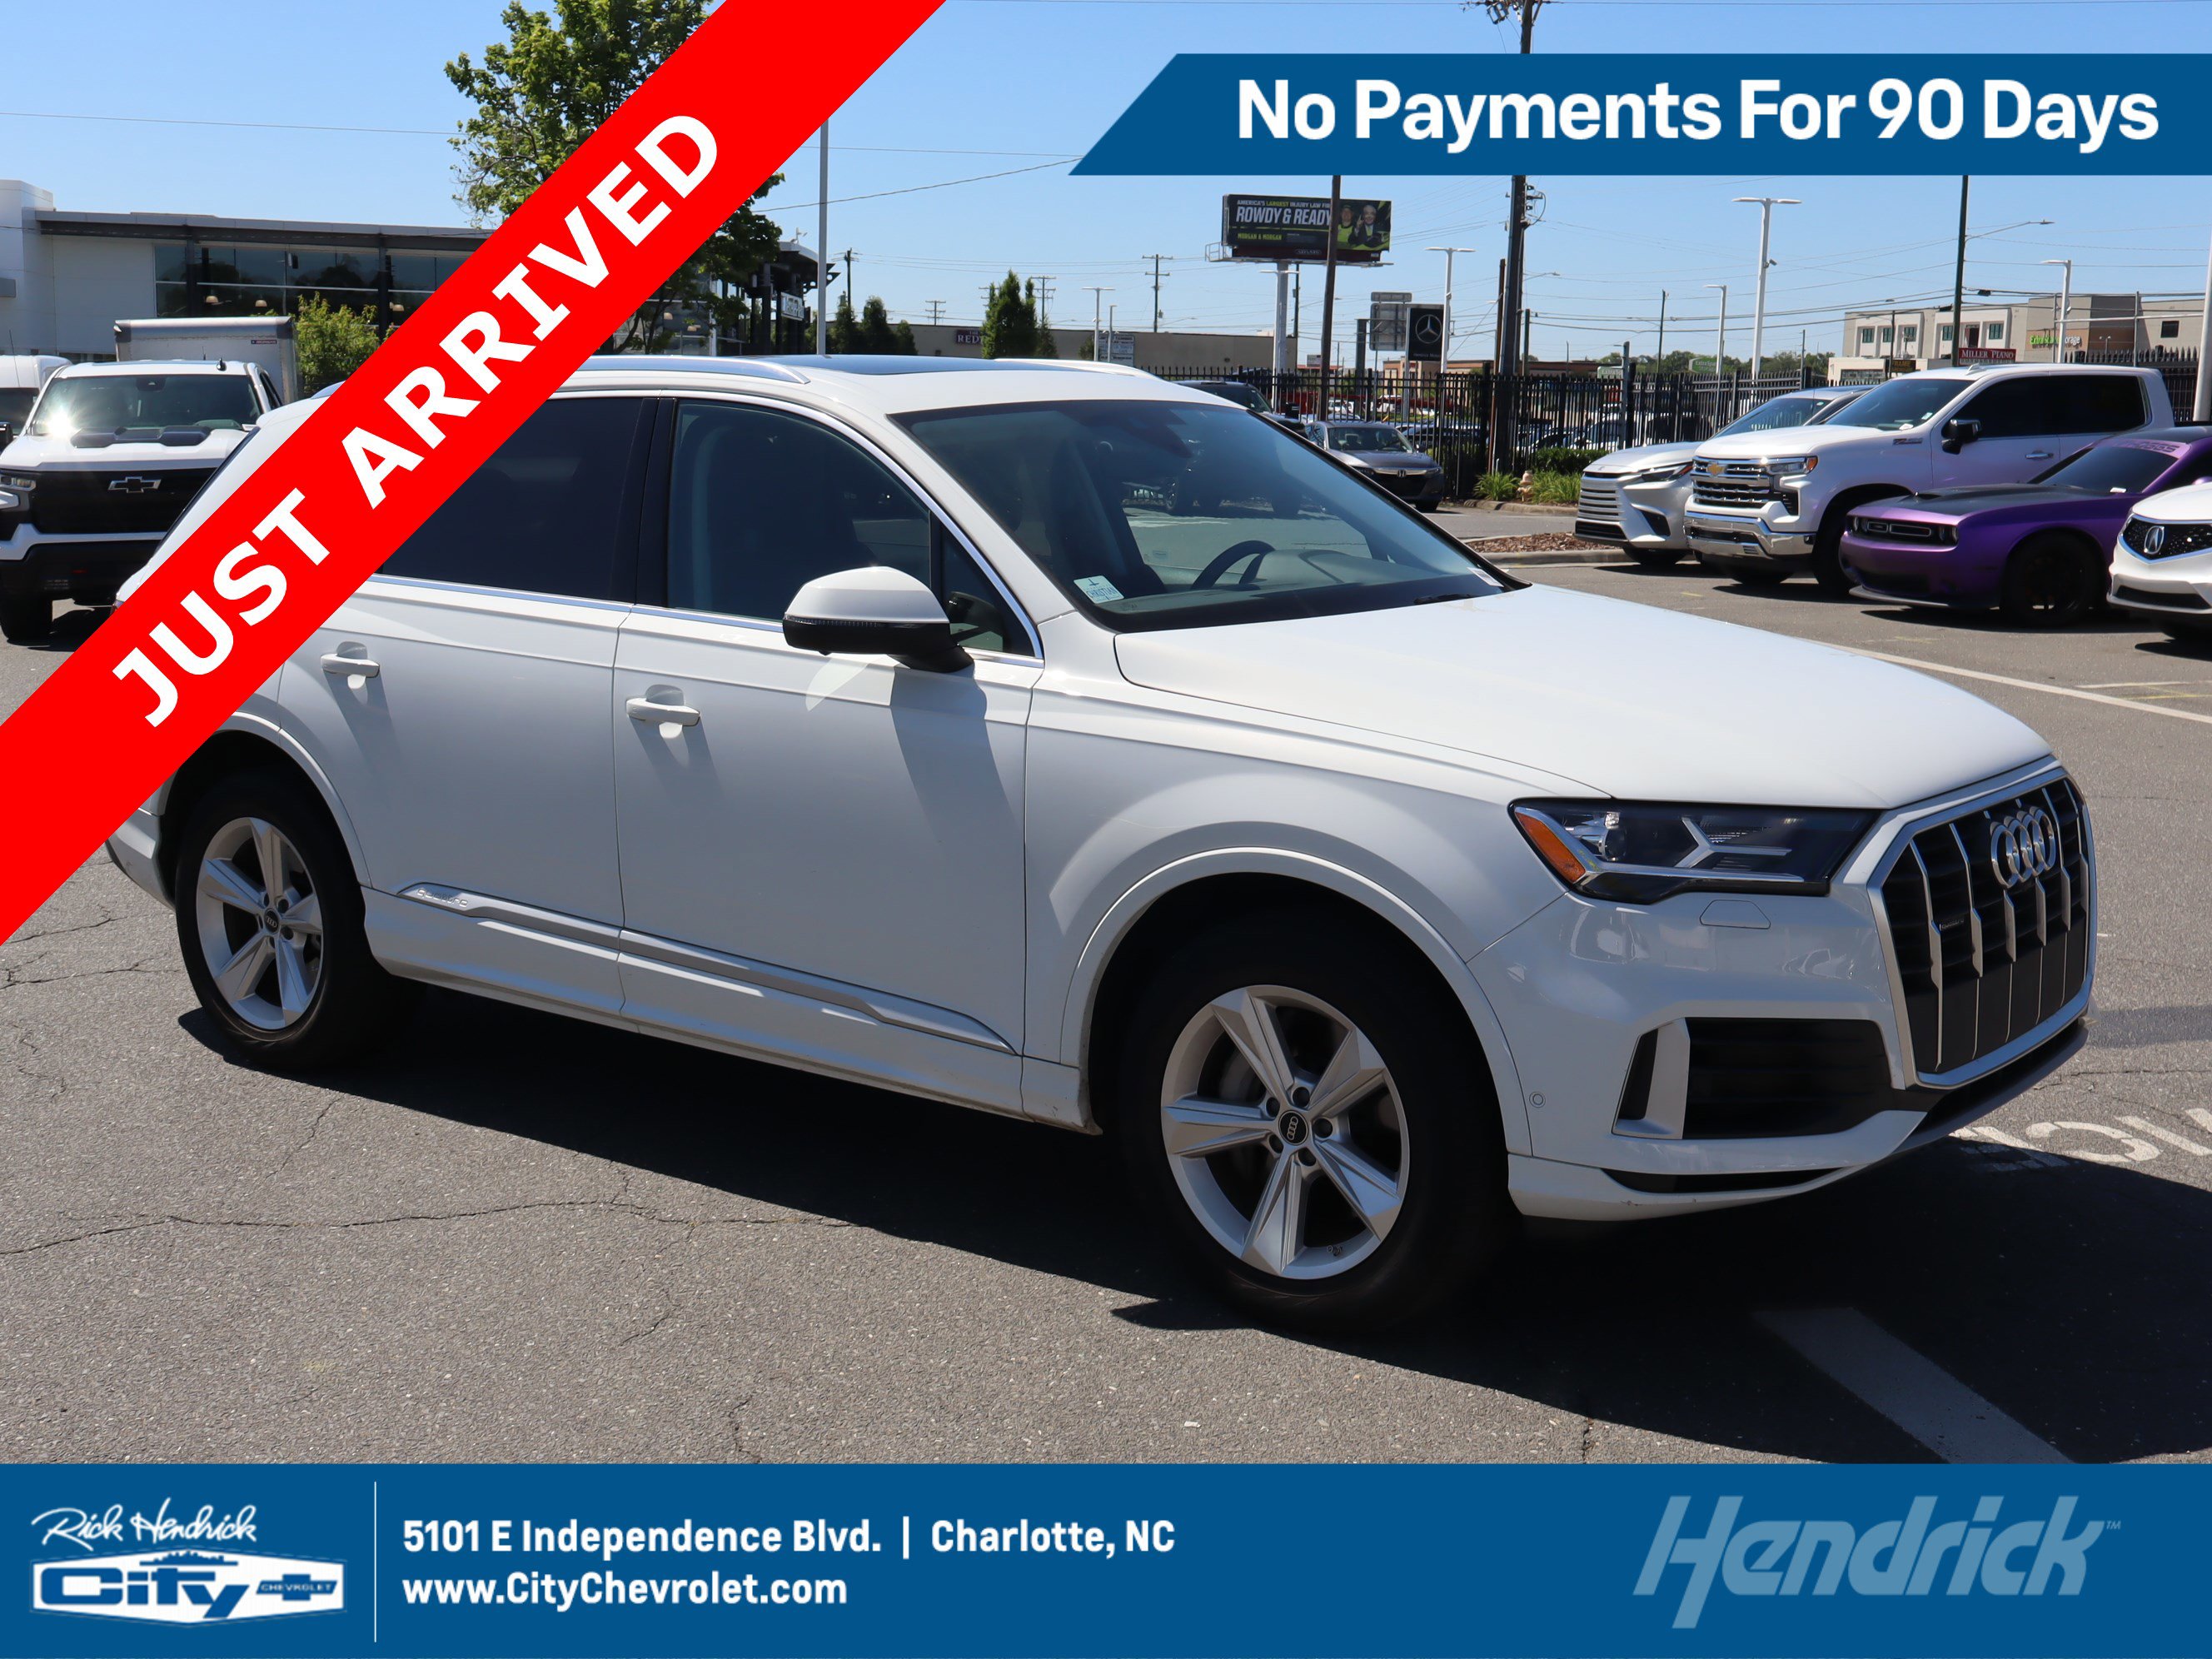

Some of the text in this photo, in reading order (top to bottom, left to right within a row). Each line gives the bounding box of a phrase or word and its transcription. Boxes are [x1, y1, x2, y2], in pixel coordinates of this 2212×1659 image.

[1236, 206, 1332, 226] ROWDY & READY
[2065, 336, 2081, 346] orage
[1961, 349, 2014, 359] MILLER PIANO
